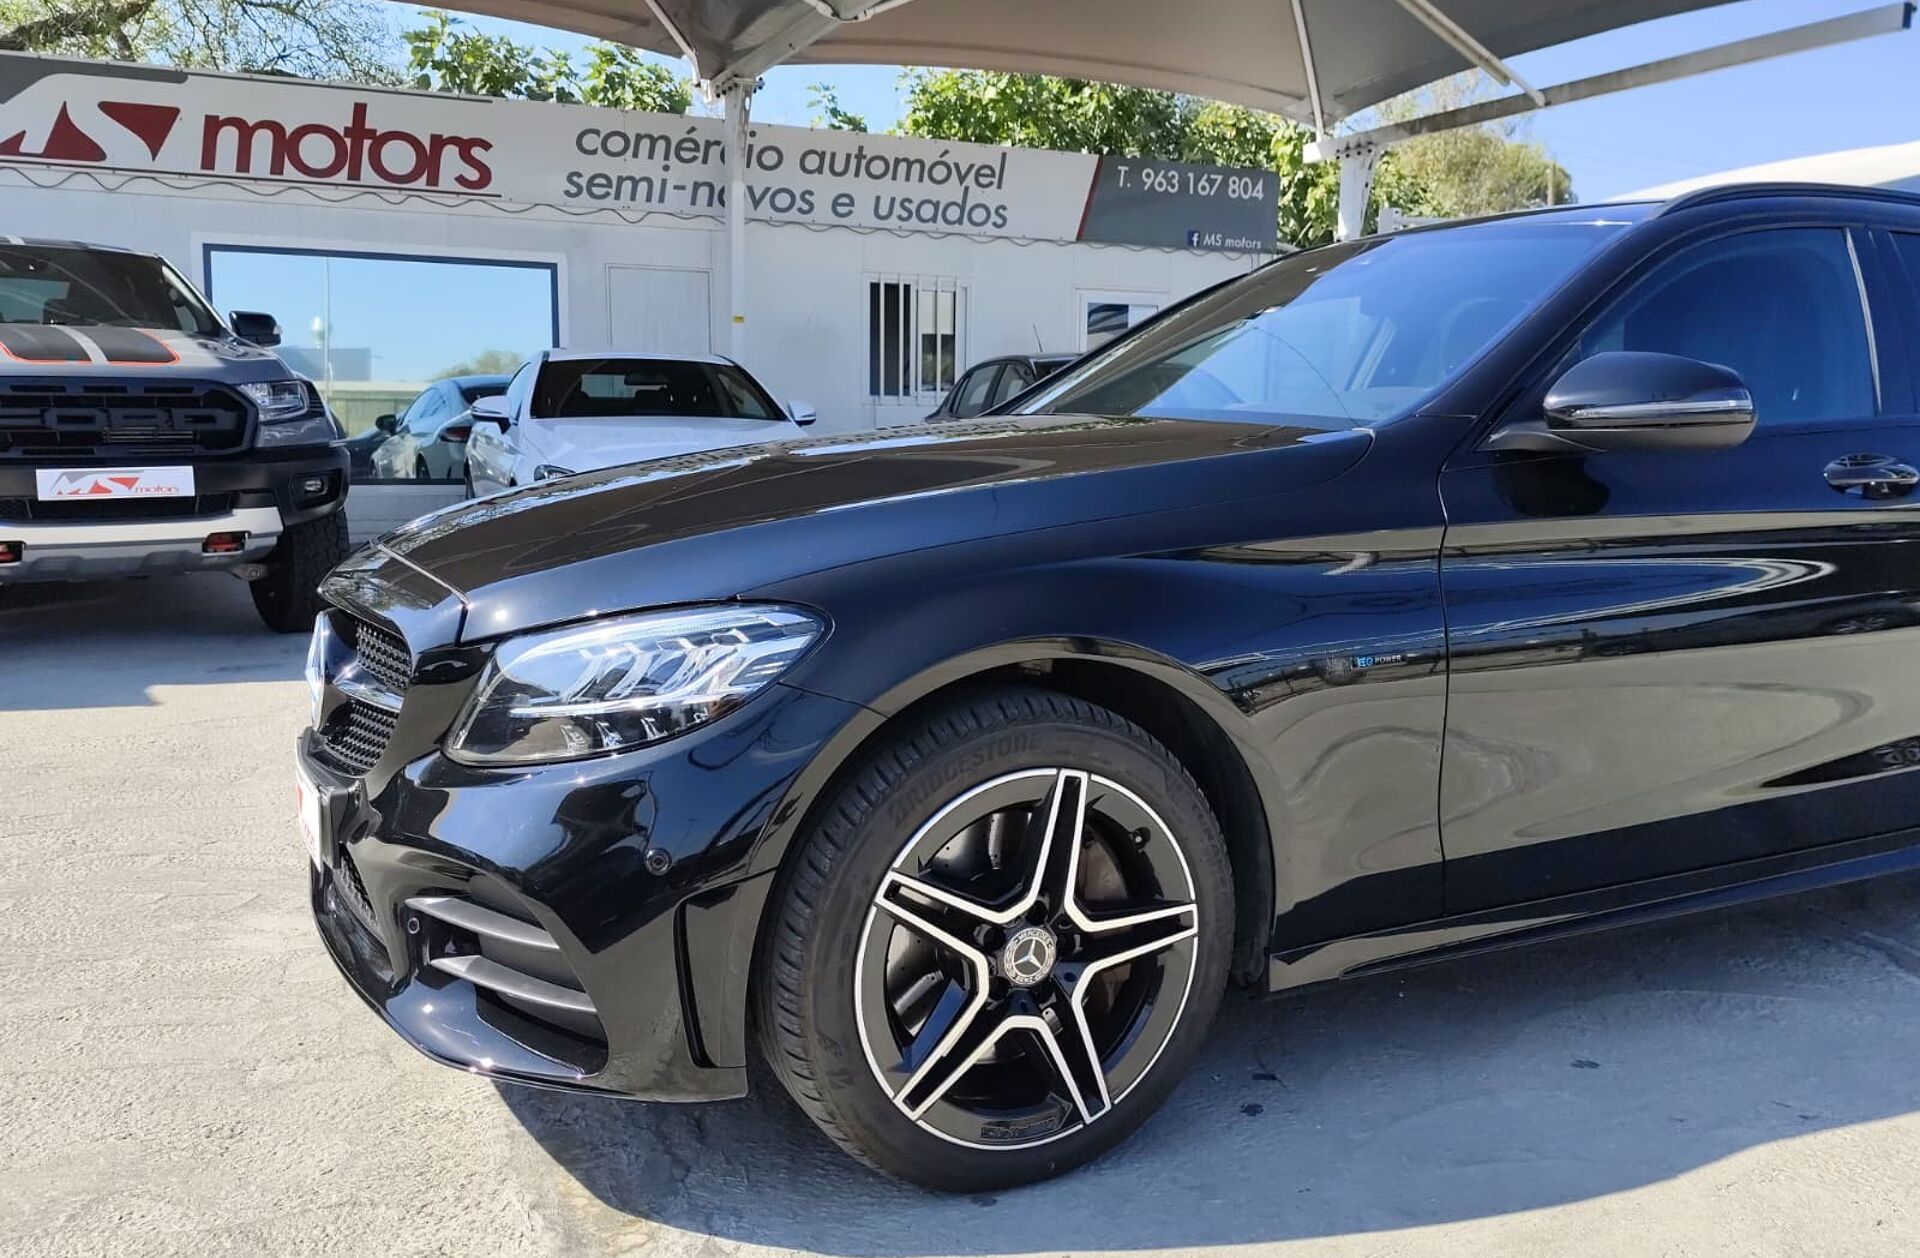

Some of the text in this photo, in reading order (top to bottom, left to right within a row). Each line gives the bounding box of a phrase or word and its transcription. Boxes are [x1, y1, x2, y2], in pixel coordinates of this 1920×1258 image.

[200, 102, 493, 190] motors
[575, 126, 1007, 190] comério automóvel
[1117, 166, 1265, 200] T. 963 167 804
[830, 191, 856, 219] e
[872, 185, 1009, 229] usados
[1203, 233, 1222, 246] MS
[1224, 235, 1262, 249] motors
